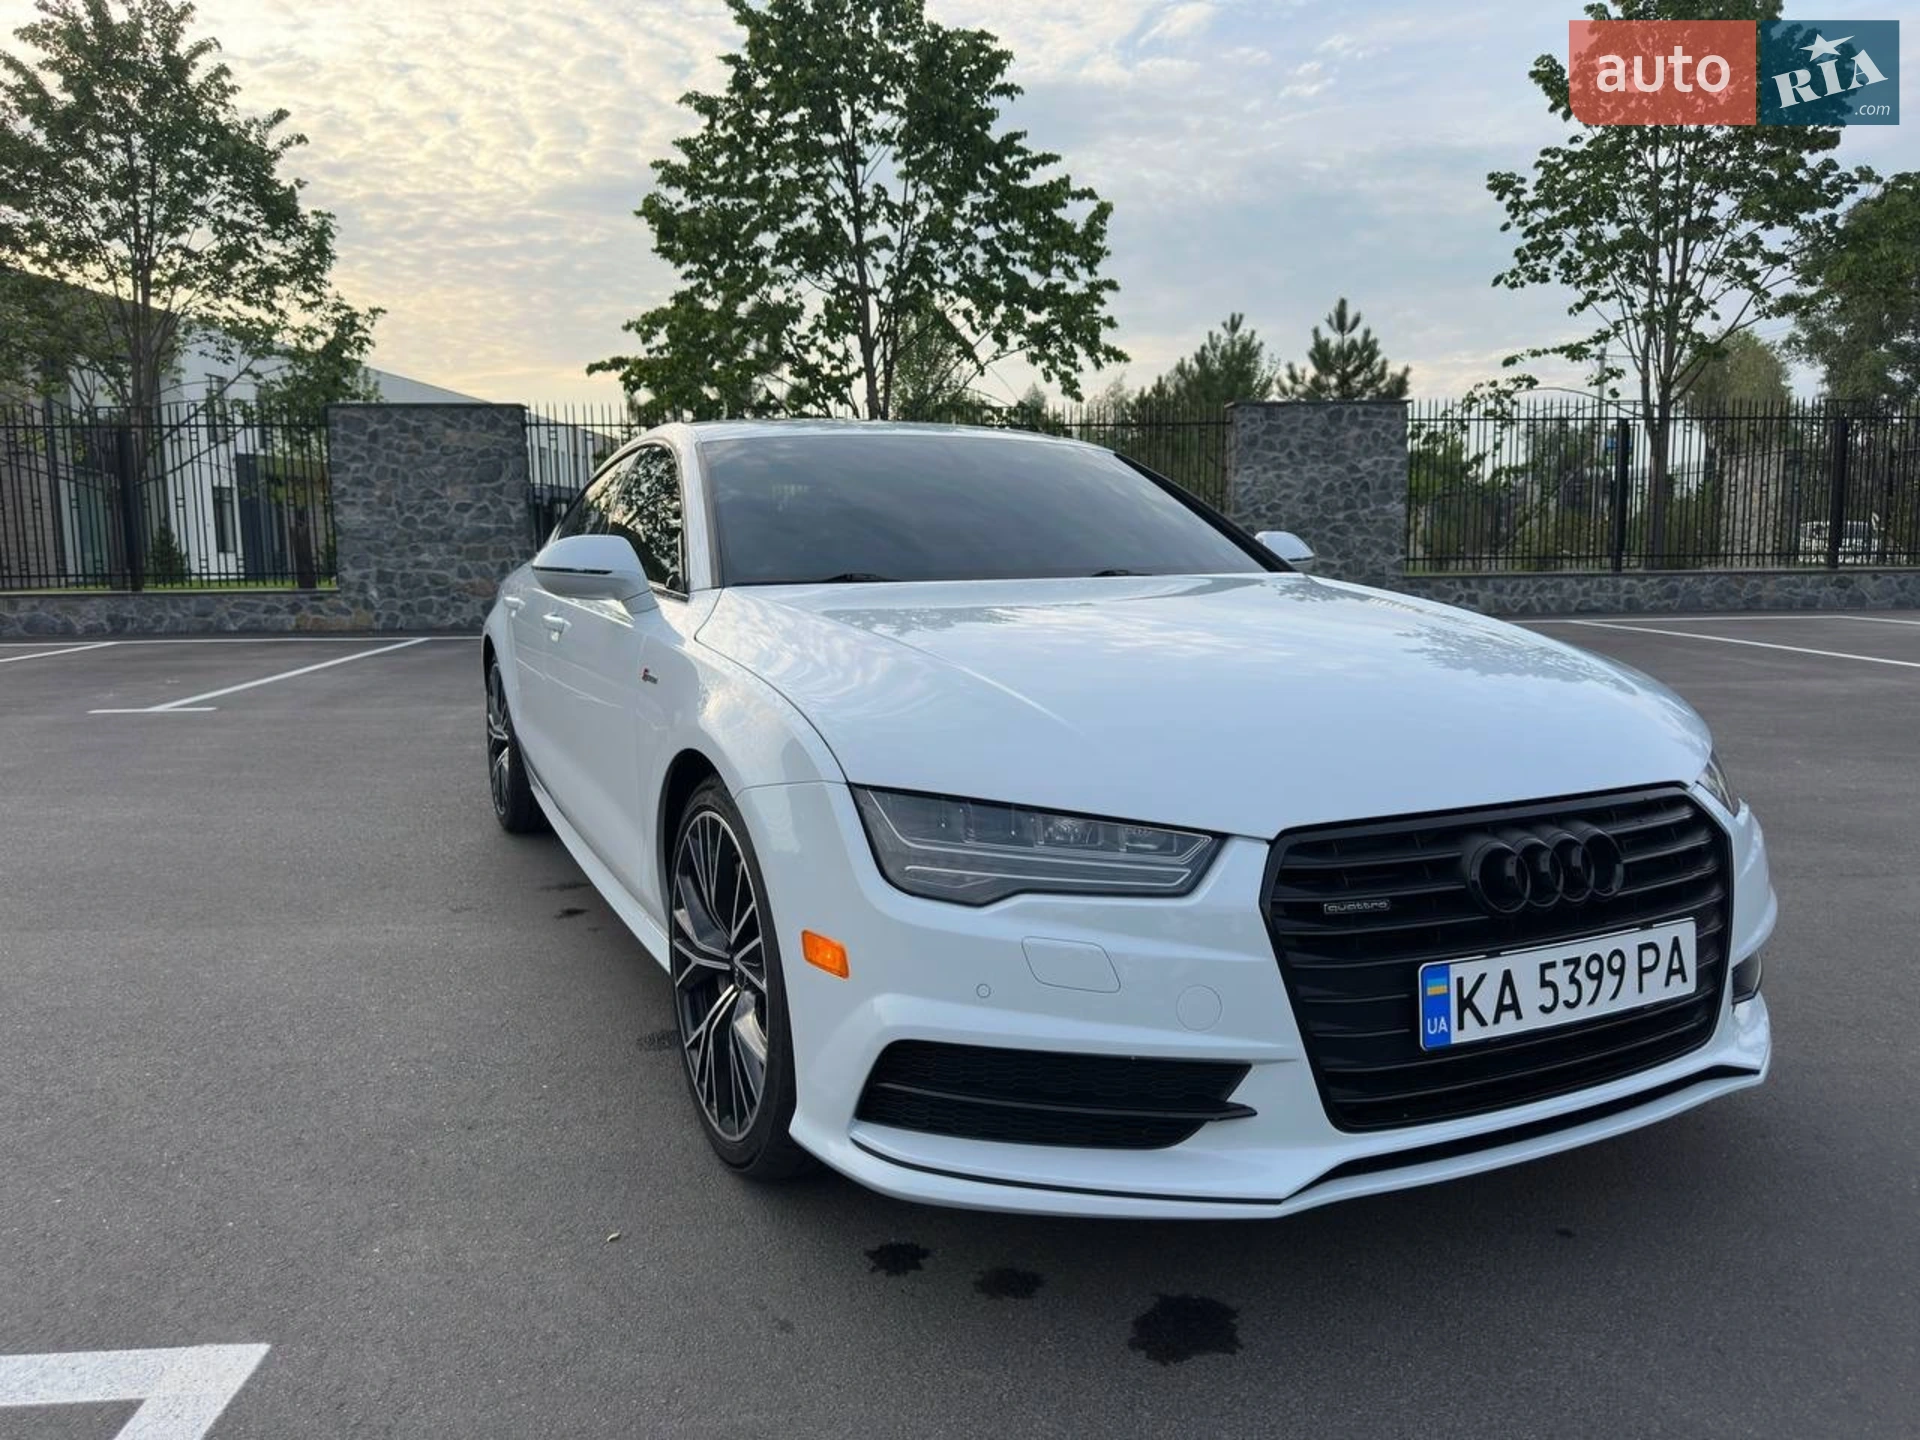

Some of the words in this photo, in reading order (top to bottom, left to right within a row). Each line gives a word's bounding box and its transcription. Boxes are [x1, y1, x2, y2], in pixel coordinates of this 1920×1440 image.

[1326, 901, 1387, 913] quattro
[1456, 968, 1523, 1031] KA
[1538, 948, 1626, 1014] 5399
[1637, 935, 1688, 994] PA
[1427, 1016, 1448, 1035] UA
